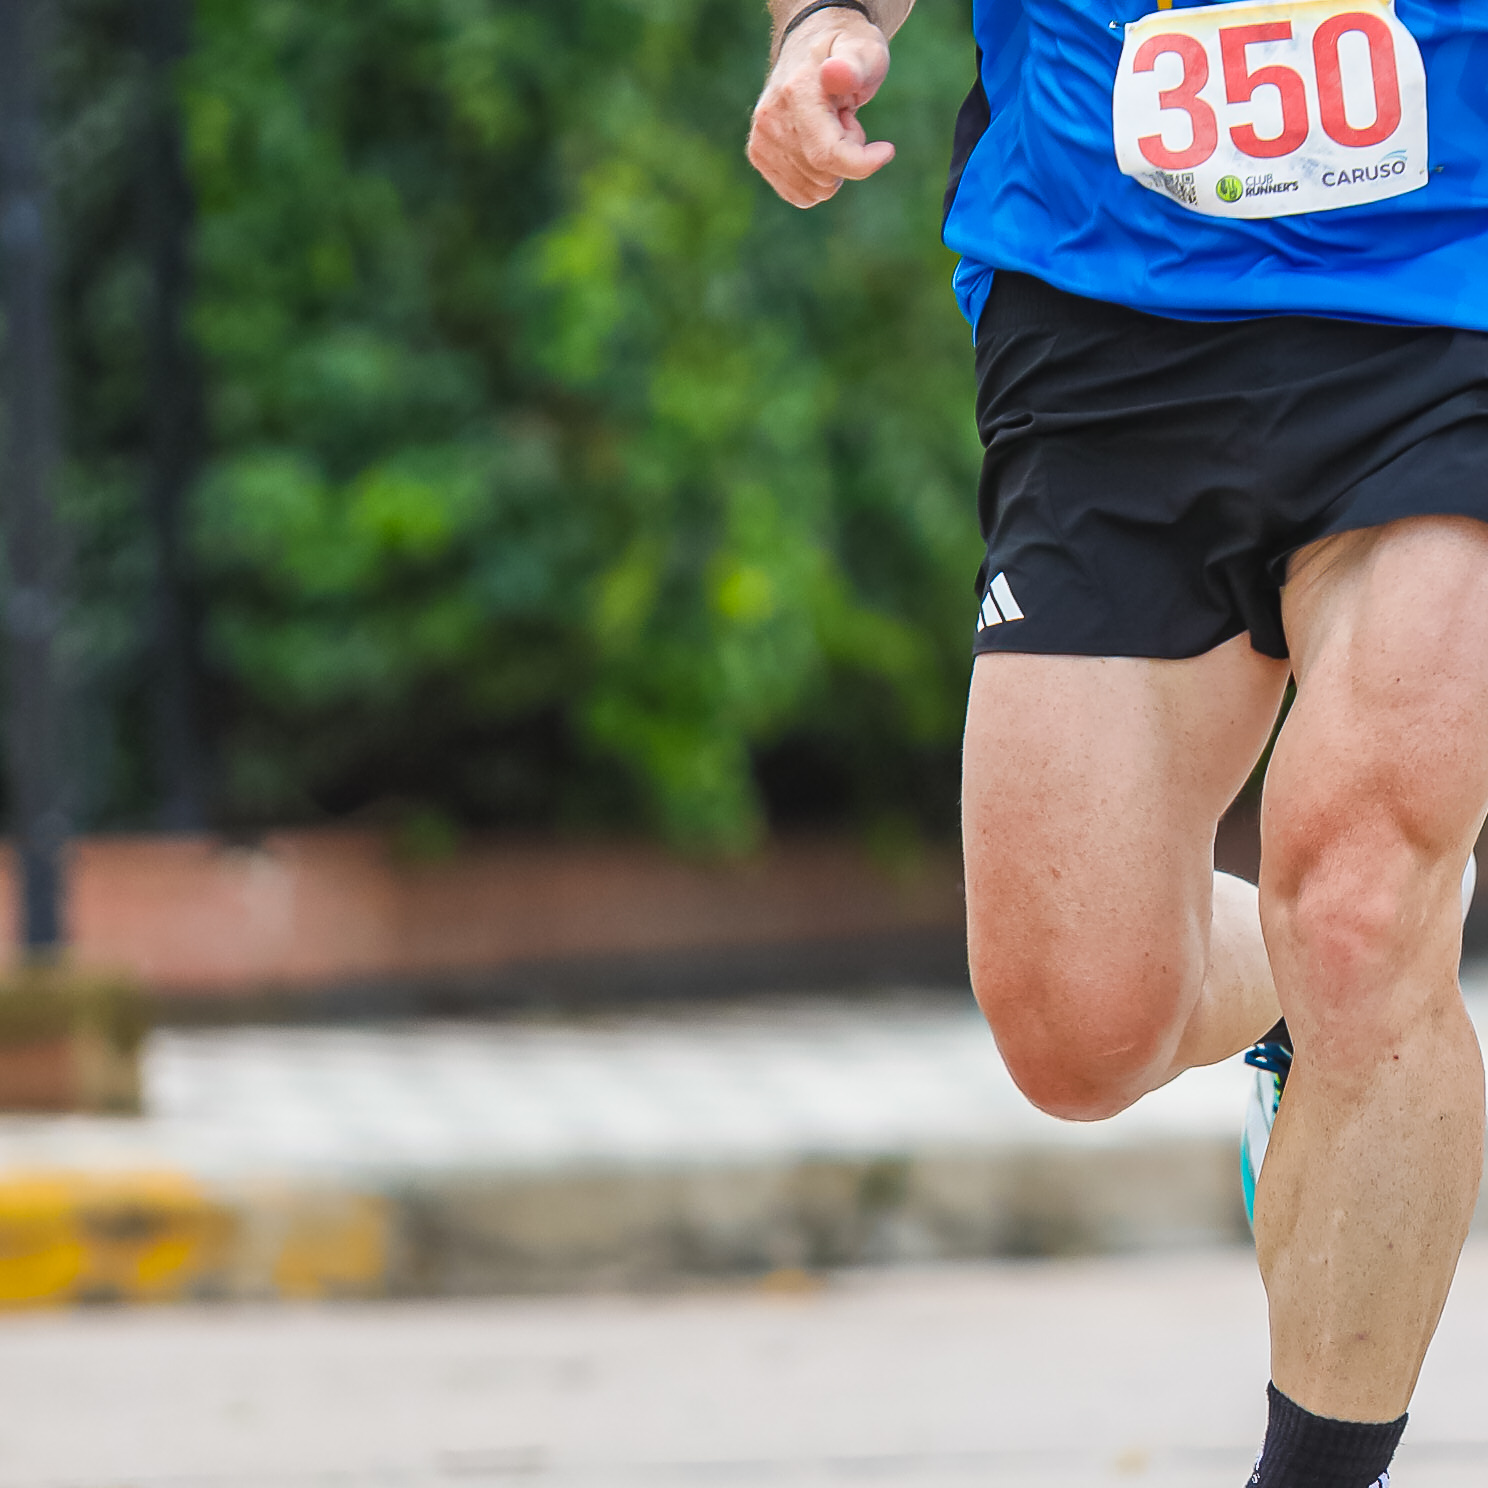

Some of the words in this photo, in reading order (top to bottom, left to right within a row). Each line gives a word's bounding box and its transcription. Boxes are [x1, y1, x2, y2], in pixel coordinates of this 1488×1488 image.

[1132, 12, 1402, 170] 350
[1245, 173, 1273, 186] CLUB
[1322, 160, 1406, 187] CARUSO
